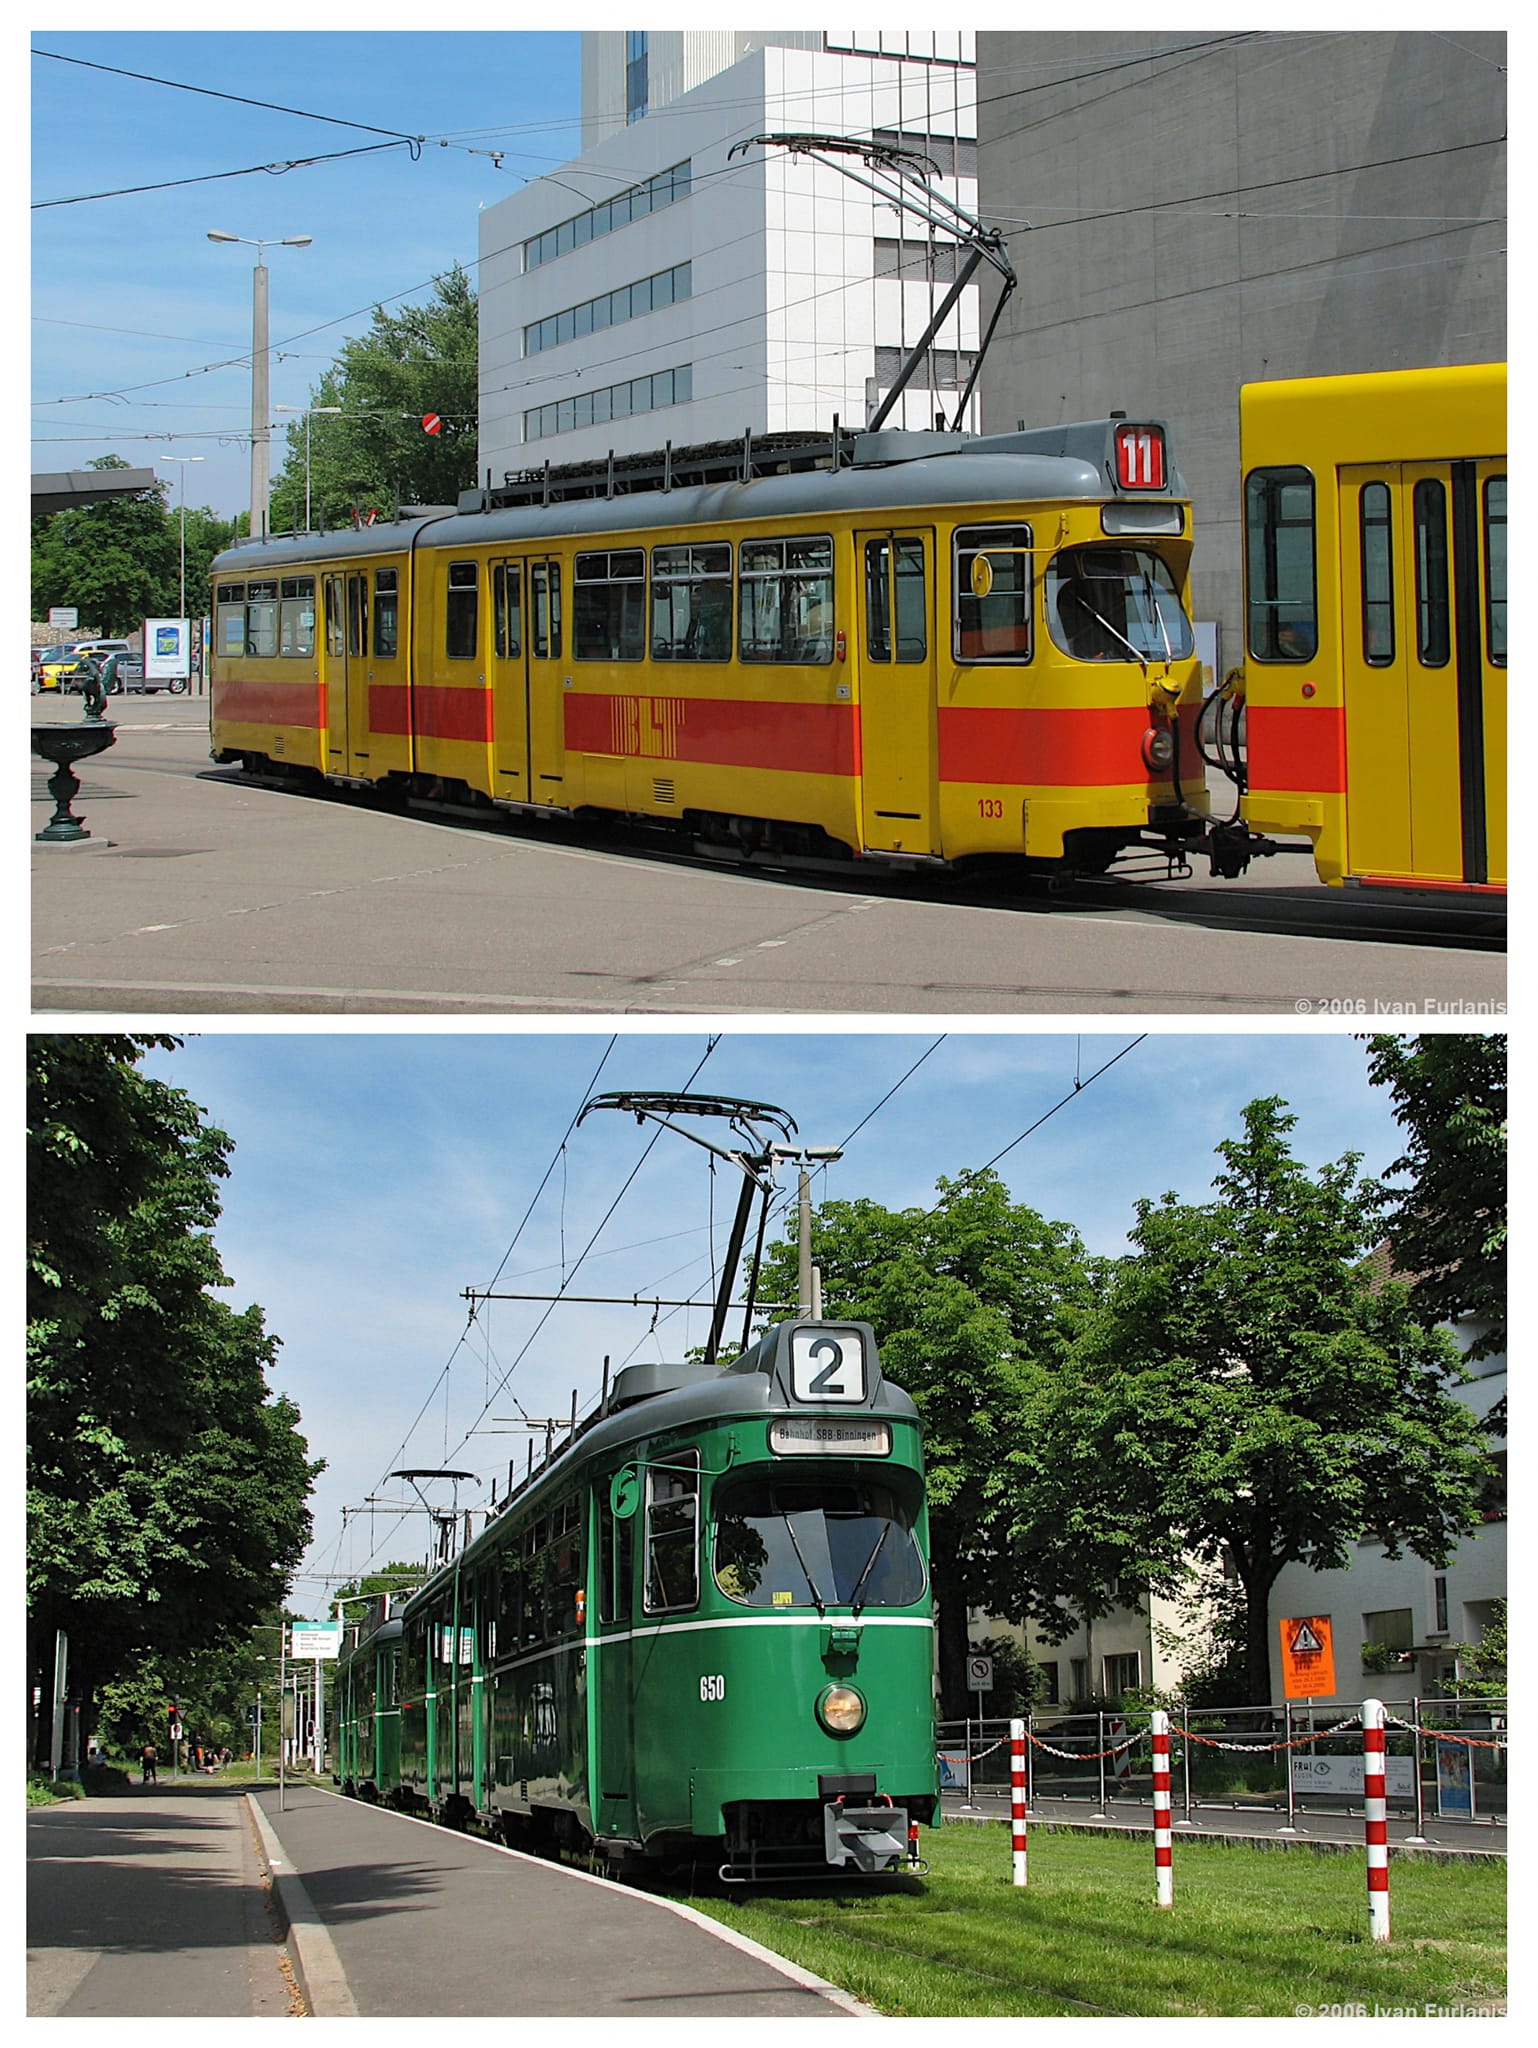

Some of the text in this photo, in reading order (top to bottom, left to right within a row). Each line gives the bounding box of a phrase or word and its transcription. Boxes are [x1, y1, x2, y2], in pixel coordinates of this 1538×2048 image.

[1122, 432, 1152, 483] 11
[977, 799, 1003, 818] 133
[808, 1337, 845, 1394] 2
[779, 1427, 813, 1440] Bahnhof
[700, 1674, 725, 1702] 650
